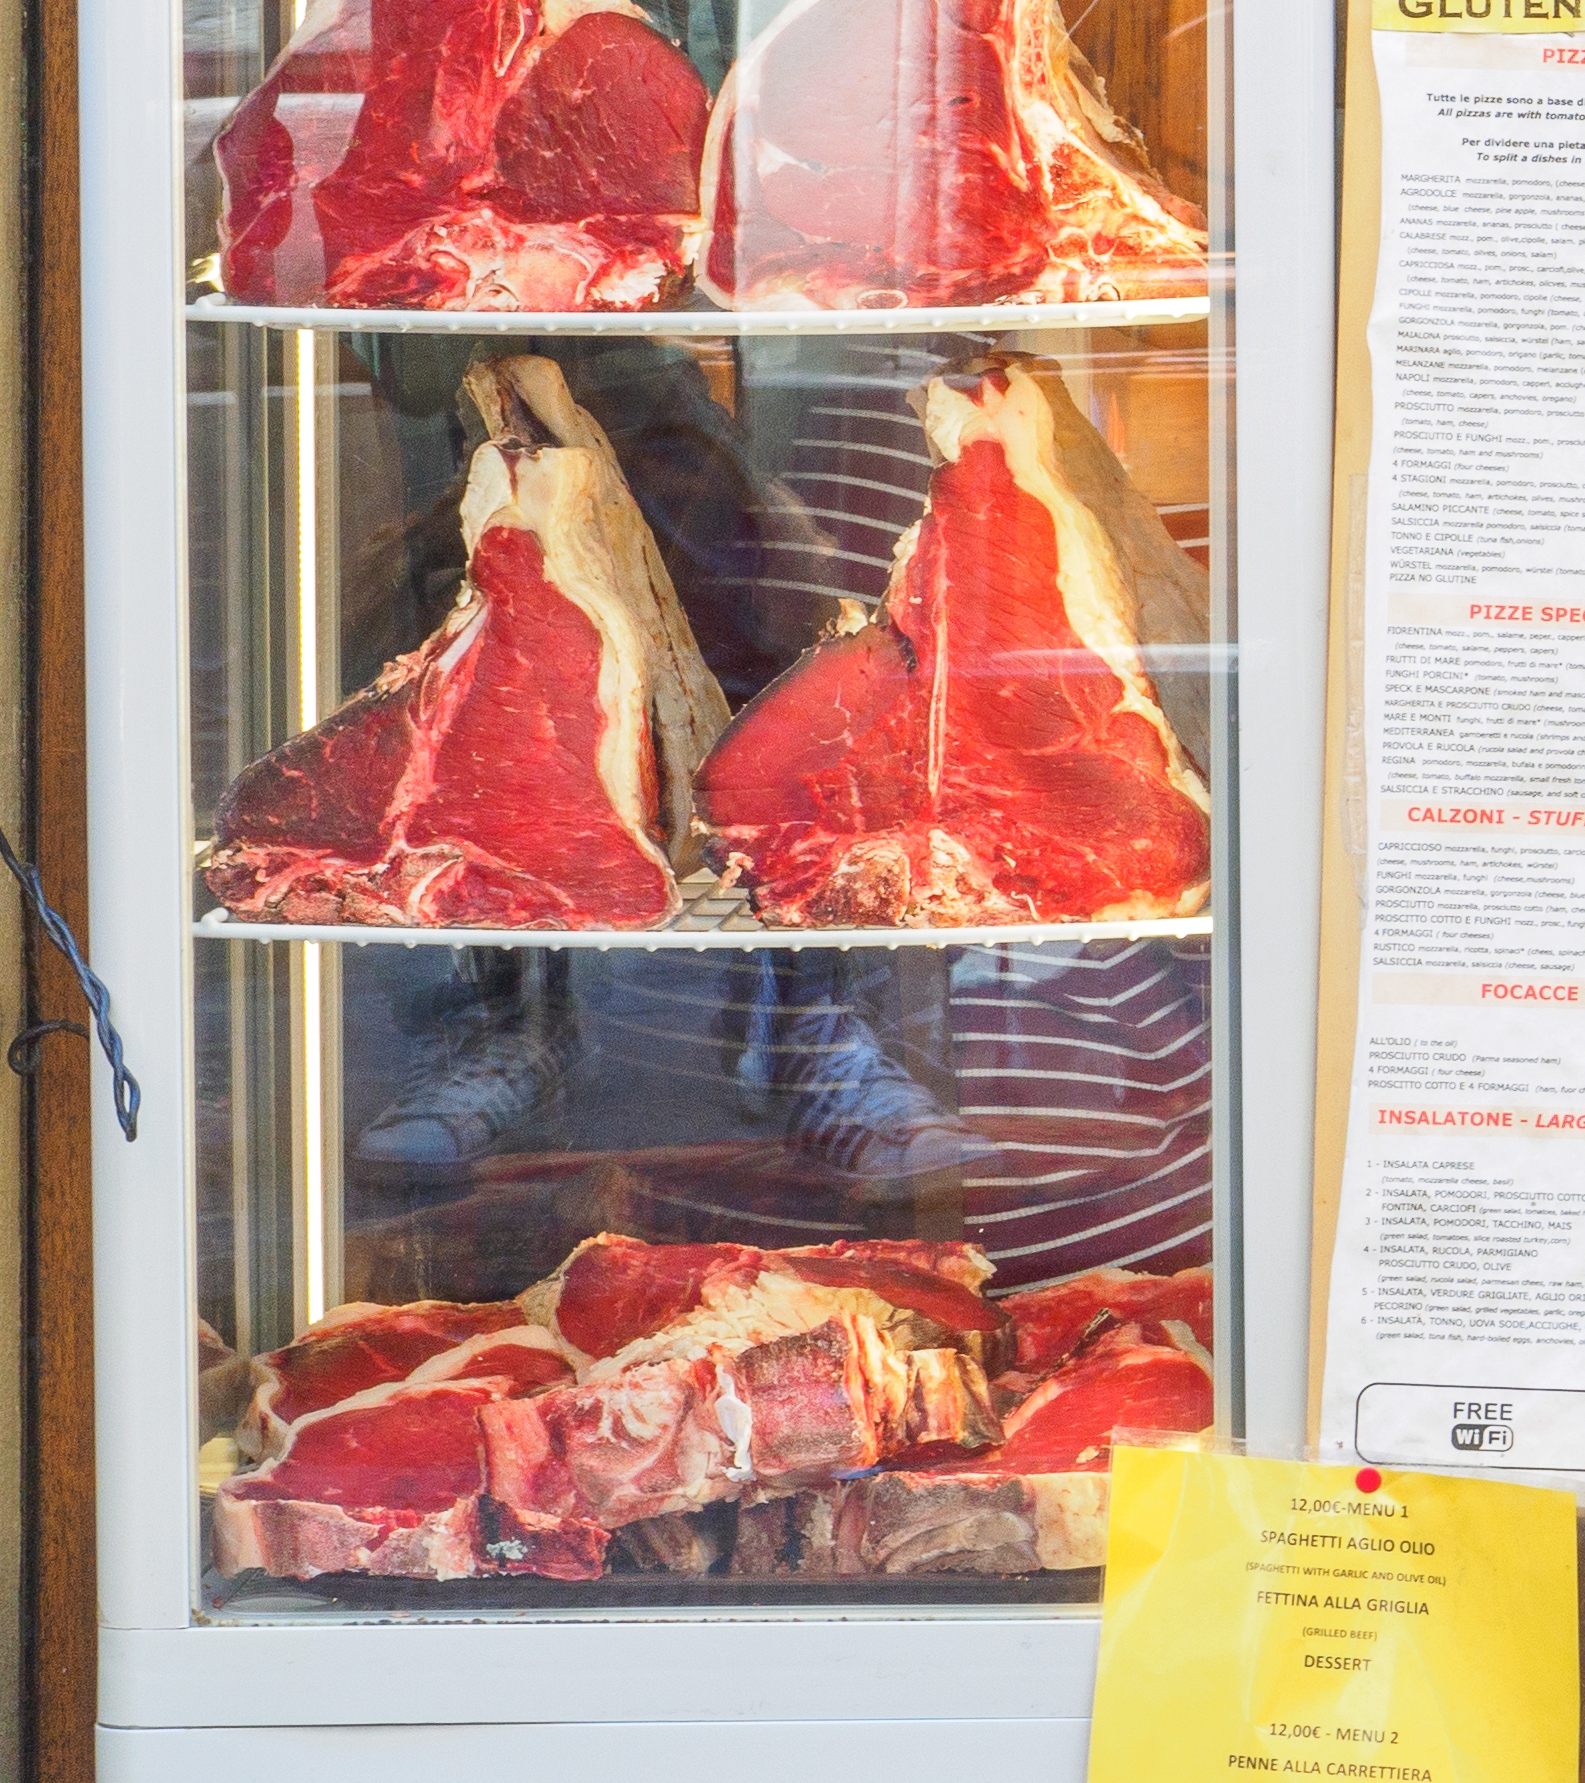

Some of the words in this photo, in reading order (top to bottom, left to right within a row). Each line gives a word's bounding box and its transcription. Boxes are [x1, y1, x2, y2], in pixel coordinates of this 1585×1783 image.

[1400, 173, 1461, 184] MARGHERITA
[1469, 603, 1533, 622] PIZZE
[1407, 806, 1505, 825] CALZONI
[1481, 983, 1579, 1002] FOCACCE
[1378, 1109, 1513, 1127] INSALATONE
[1453, 1401, 1513, 1421] FREE
[1452, 1425, 1513, 1450] WiFi
[1261, 1530, 1342, 1549] SPAGHETTI
[1346, 1537, 1396, 1553] AGLIO
[1399, 1540, 1436, 1556] OLIO
[1257, 1590, 1319, 1608] FETTINA
[1323, 1595, 1362, 1610] ALLA
[1366, 1598, 1430, 1616] GRIGLIA
[1304, 1654, 1371, 1671] DESSERT
[1270, 1722, 1321, 1739] 12,00€
[1335, 1727, 1386, 1744] MENU
[1390, 1731, 1399, 1745] 2
[1228, 1754, 1278, 1772] PENNE
[1282, 1759, 1321, 1775] ALLA
[1326, 1762, 1432, 1783] CARRETTIERA
